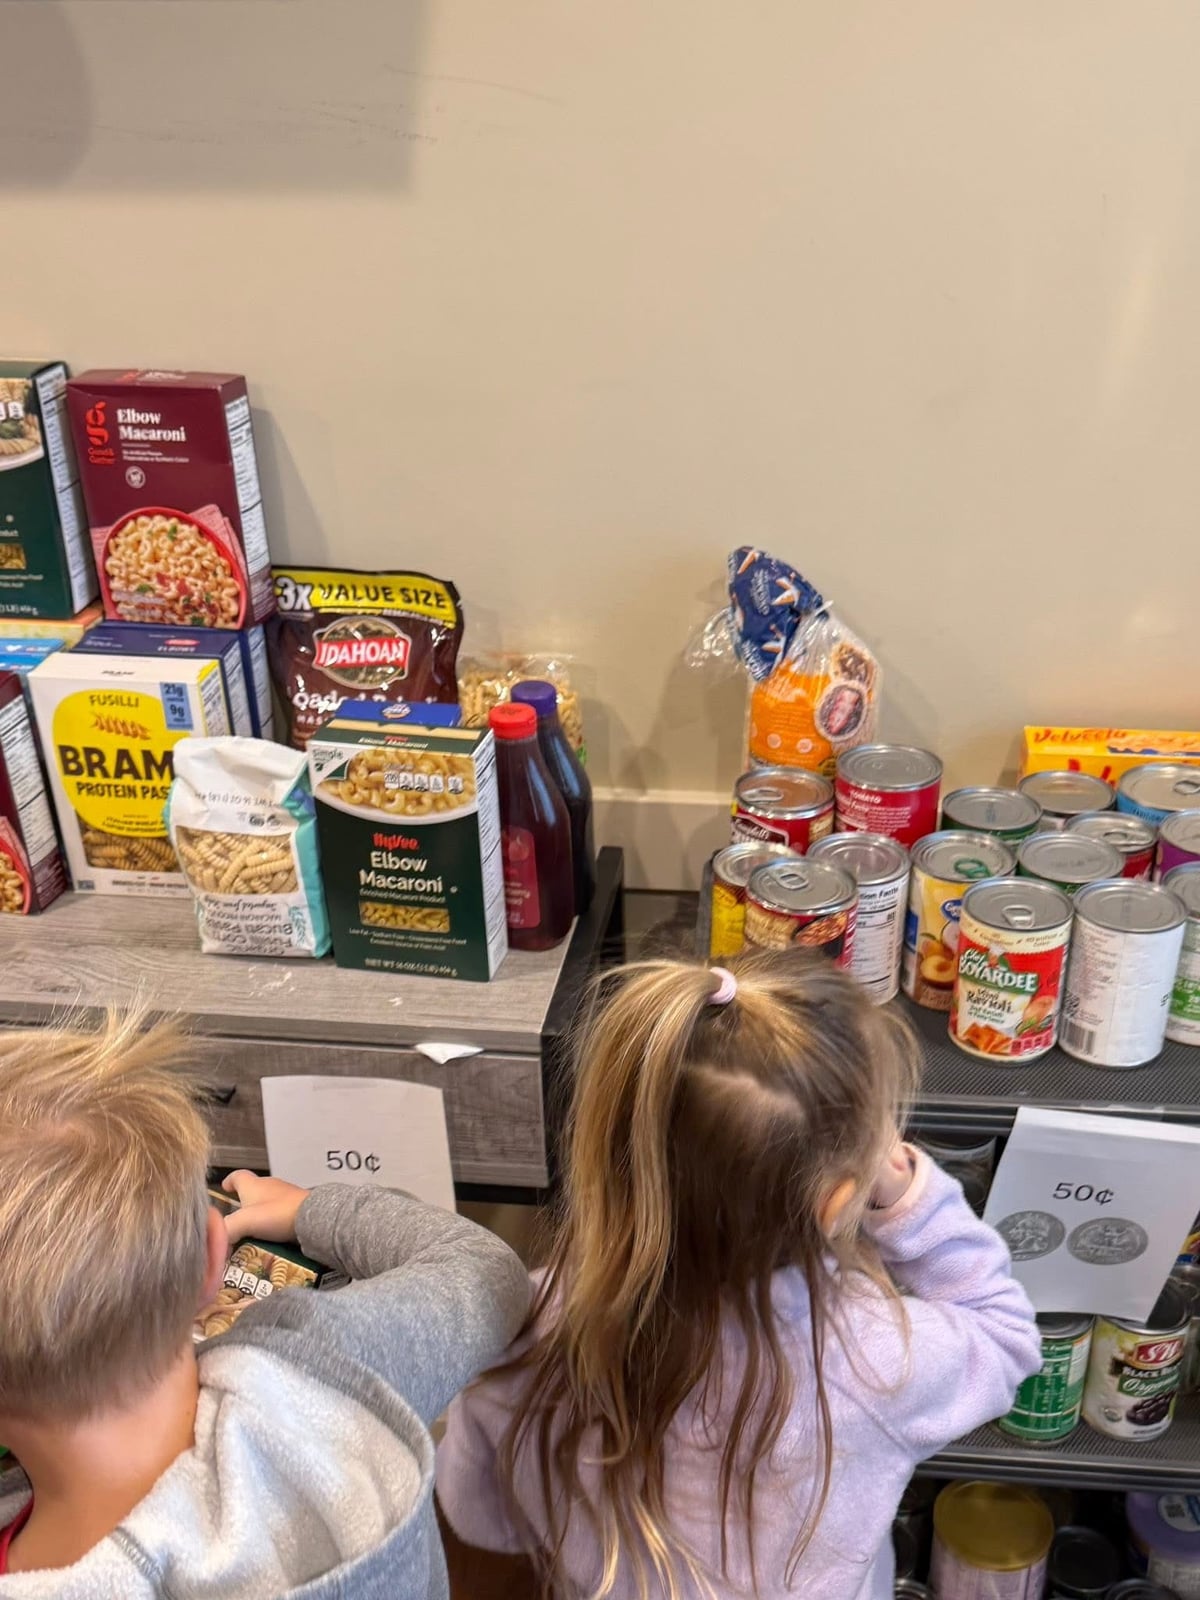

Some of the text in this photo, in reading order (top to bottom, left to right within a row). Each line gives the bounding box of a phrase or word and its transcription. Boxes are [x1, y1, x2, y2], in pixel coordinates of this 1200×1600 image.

[117, 408, 161, 424] Elbow
[119, 426, 187, 442] Macaroni
[318, 583, 396, 602] VALUE
[400, 587, 448, 609] SIZE
[319, 639, 405, 667] IDAHOAN
[88, 694, 140, 708] FUSILLI
[163, 683, 184, 697] 21g
[169, 704, 185, 717] 9g
[58, 744, 175, 782] BRAM
[76, 782, 171, 800] PROTEIN PAS
[370, 850, 428, 872] Elbow
[359, 869, 444, 894] Macaroni
[958, 960, 1040, 993] BOYARDEE
[326, 1149, 382, 1174] 50¢
[1052, 1181, 1114, 1206] 50¢
